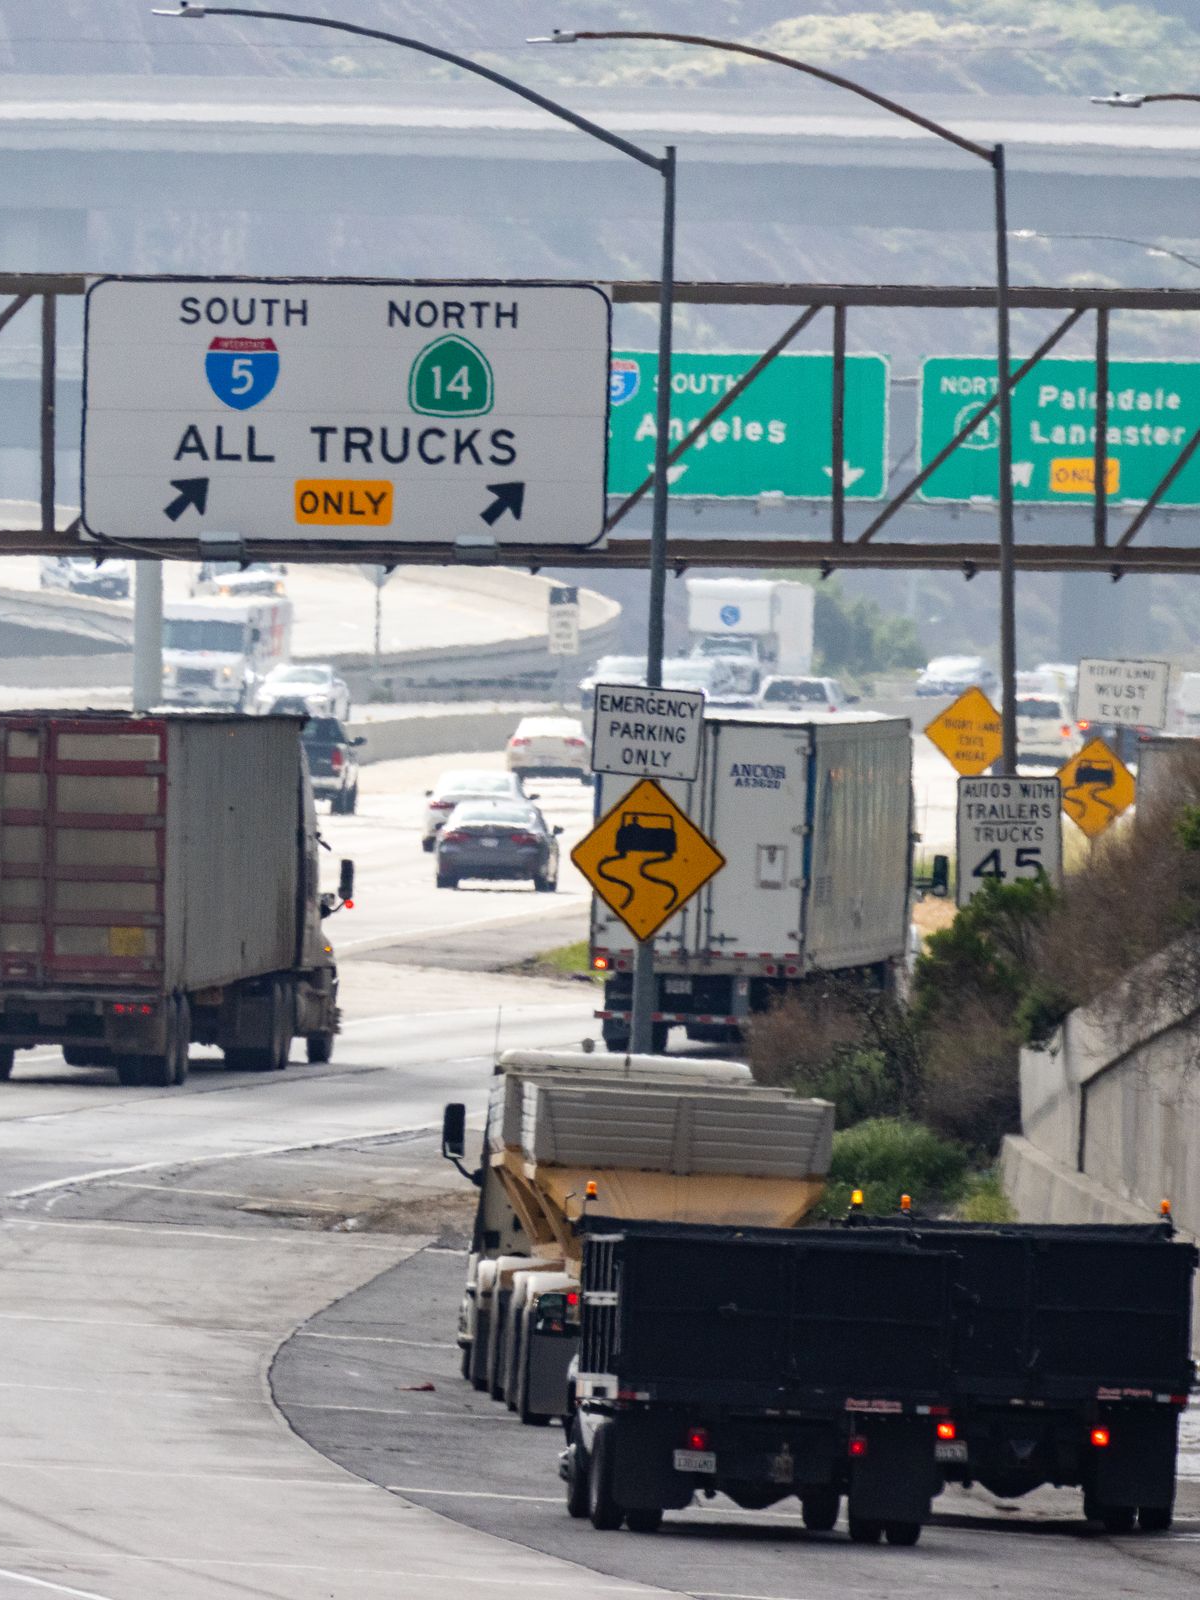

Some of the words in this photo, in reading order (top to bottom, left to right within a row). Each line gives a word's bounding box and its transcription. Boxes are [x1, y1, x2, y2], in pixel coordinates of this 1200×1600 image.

[179, 297, 309, 327] SOUTH
[388, 300, 518, 330] NORTH
[232, 359, 254, 395] 5
[431, 366, 473, 400] 14
[940, 376, 1016, 397] NORT
[174, 425, 275, 462] ALL
[310, 426, 517, 466] TRUCKS
[299, 490, 387, 516] ONLY
[1096, 684, 1148, 700] MUST
[600, 695, 699, 719] EMERGENCY
[1099, 703, 1142, 719] EXIT
[610, 721, 686, 744] PARKING
[622, 749, 672, 767] ONLY
[965, 783, 1011, 799] AUTOS
[1019, 784, 1055, 799] WITH
[966, 803, 1052, 820] TRAILERS
[974, 827, 1044, 844] TRUCKS
[972, 847, 1044, 881] 45
